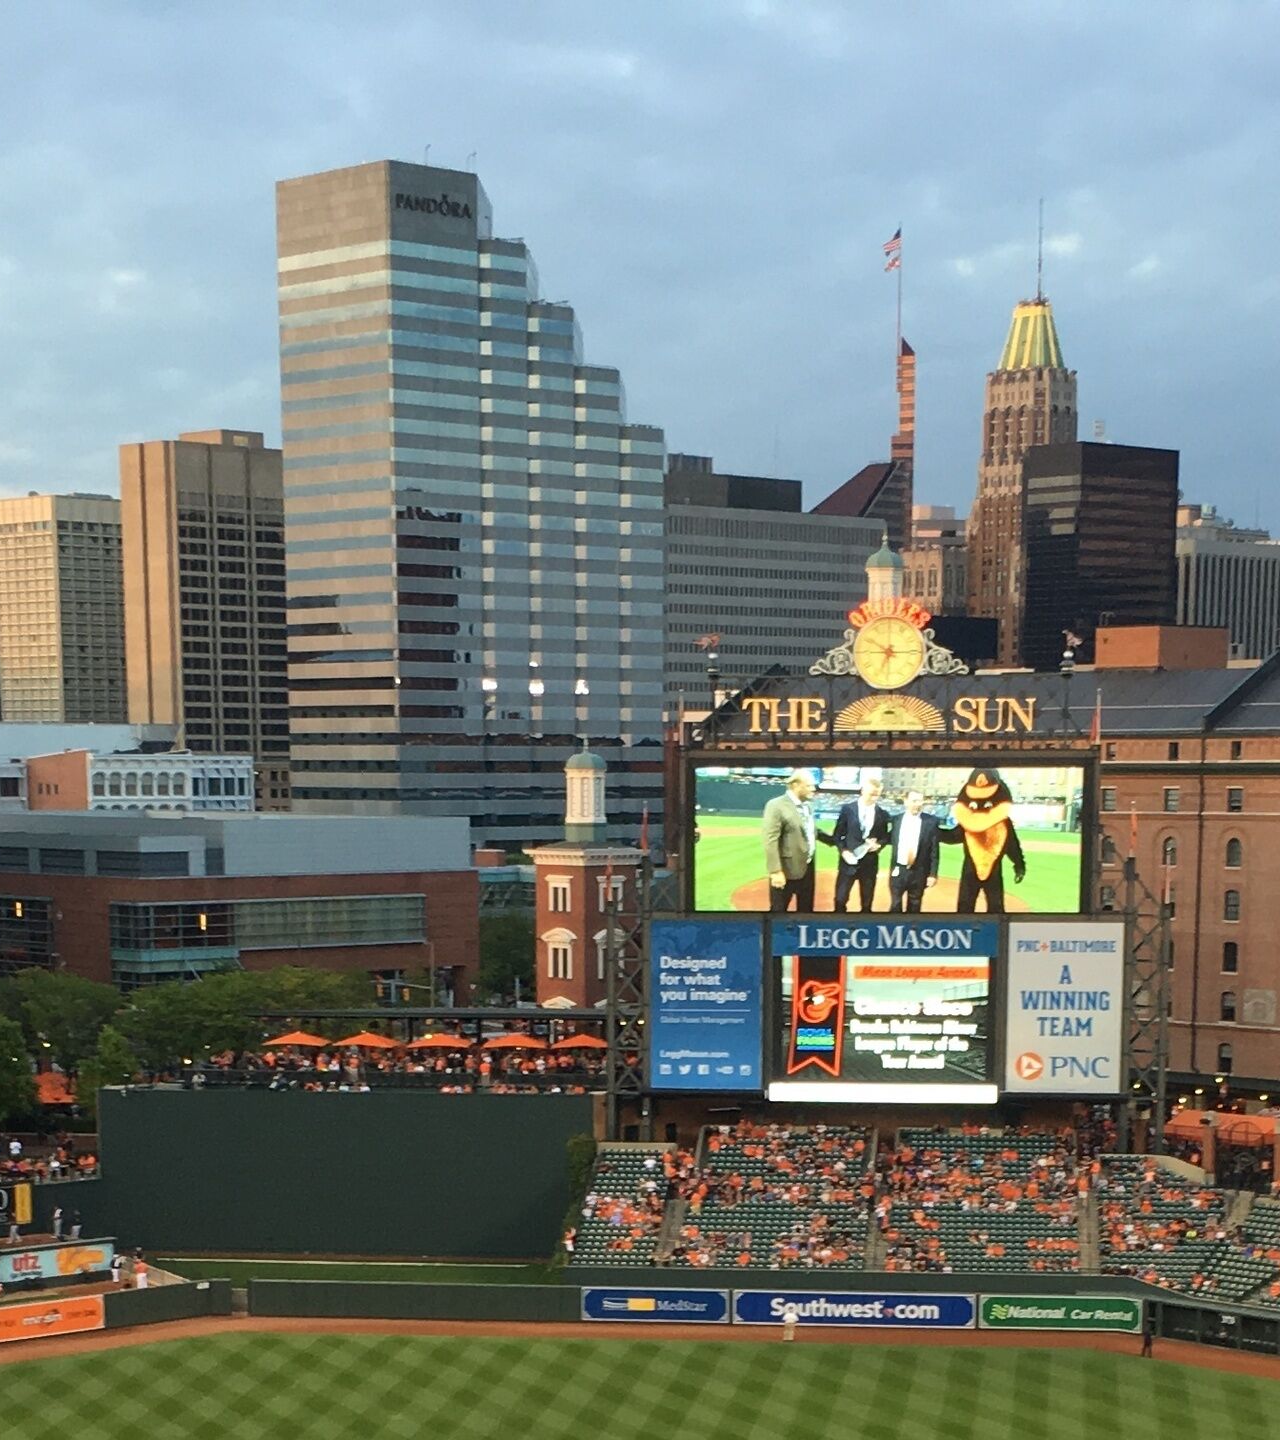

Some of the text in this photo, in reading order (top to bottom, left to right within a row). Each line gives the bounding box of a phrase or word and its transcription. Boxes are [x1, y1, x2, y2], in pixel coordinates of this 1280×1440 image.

[741, 697, 1037, 733] THE SUN
[797, 925, 973, 950] LEGG MASON
[1050, 940, 1117, 953] BALTIMORE
[660, 955, 727, 972] Designed
[660, 972, 722, 986] for what
[1058, 964, 1073, 985] A
[660, 988, 748, 1005] you imagine
[1021, 990, 1111, 1011] WINNING
[1036, 1017, 1093, 1036] TEAM
[1049, 1056, 1111, 1079] PNC
[1007, 1305, 1067, 1319] National
[1070, 1309, 1094, 1320] Car
